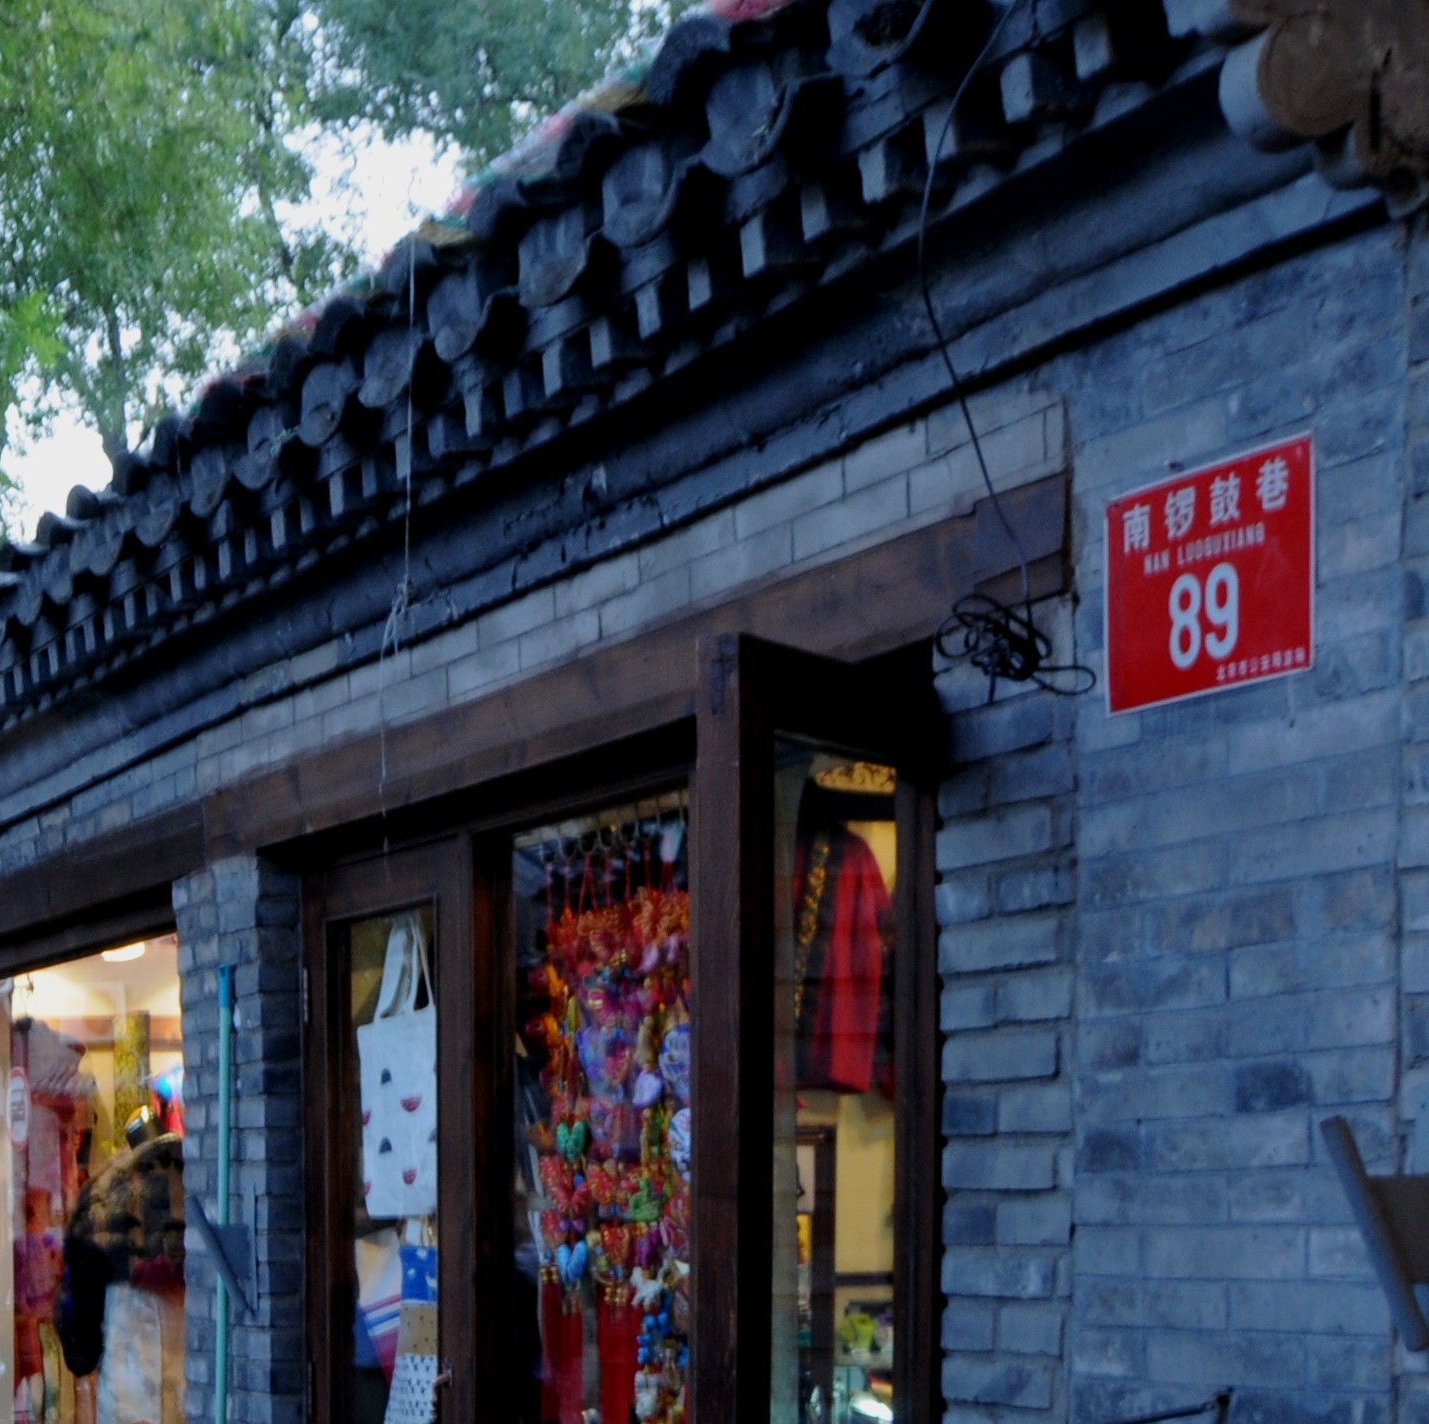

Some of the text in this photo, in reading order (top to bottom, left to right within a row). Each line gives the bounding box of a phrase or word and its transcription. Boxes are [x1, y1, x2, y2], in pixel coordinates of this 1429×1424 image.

[1123, 457, 1289, 554] 南锣鼓巷
[1144, 550, 1170, 575] NAN
[1169, 562, 1240, 671] 89
